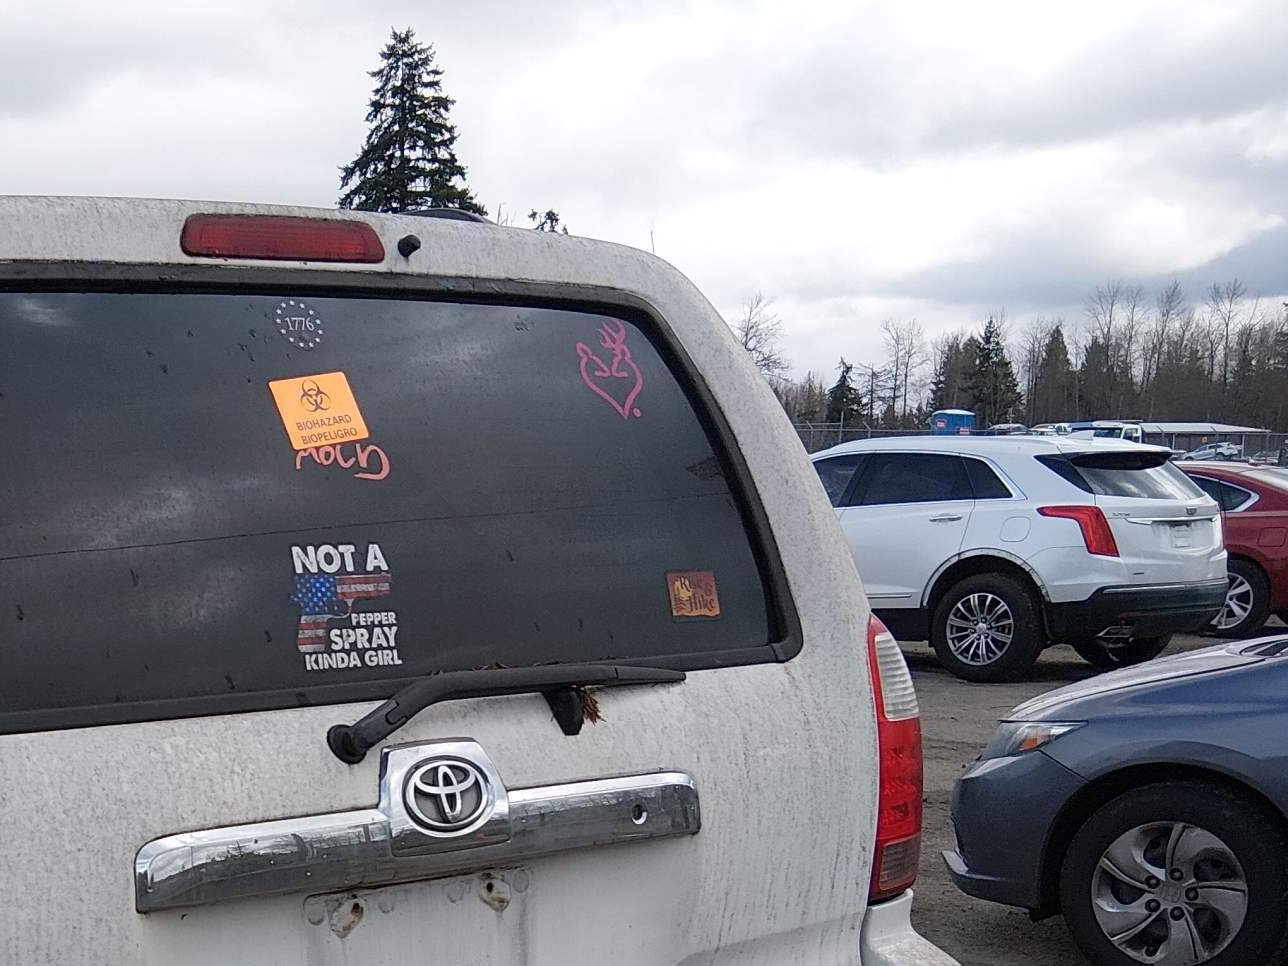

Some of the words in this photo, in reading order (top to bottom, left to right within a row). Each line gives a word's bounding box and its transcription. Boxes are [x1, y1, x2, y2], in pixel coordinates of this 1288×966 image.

[284, 316, 314, 331] 1776
[296, 414, 352, 431] BIOHAZARD
[301, 427, 358, 444] BIOPELIGRO
[291, 544, 355, 574] NOT
[365, 543, 389, 571] A
[351, 611, 397, 626] PEPPER
[329, 626, 398, 651] SPRAY
[304, 651, 362, 671] KINDA
[364, 649, 403, 667] GIRL
